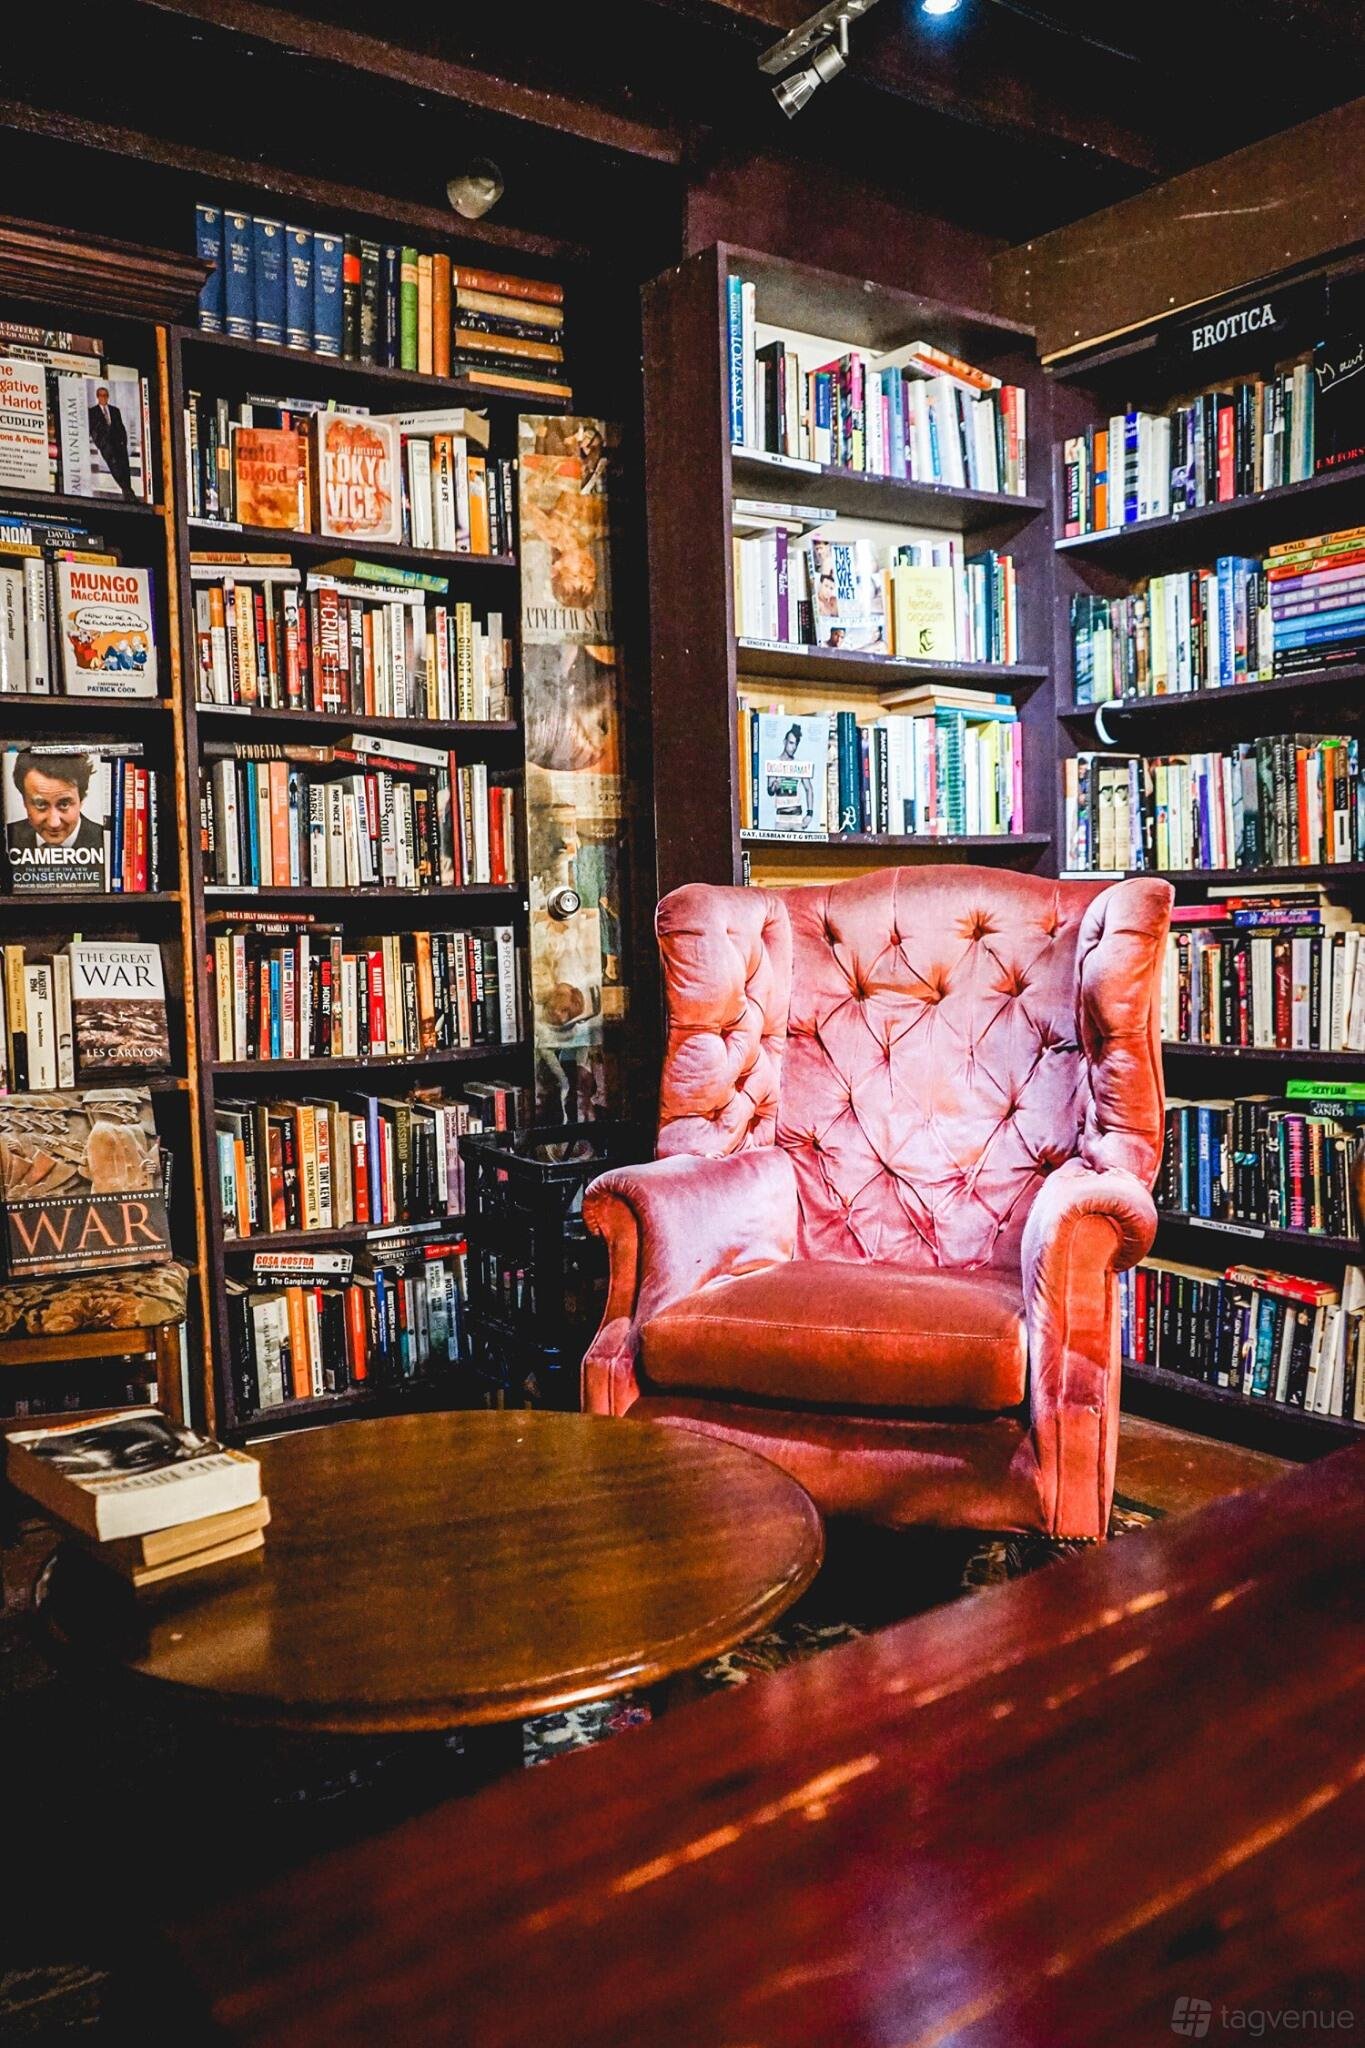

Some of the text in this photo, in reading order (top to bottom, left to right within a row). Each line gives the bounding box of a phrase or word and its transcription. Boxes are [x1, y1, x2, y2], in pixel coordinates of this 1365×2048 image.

[1191, 304, 1277, 352] EROTICA
[731, 336, 743, 373] LOVE
[0, 379, 38, 396] gative
[3, 395, 42, 411] Harlot
[0, 415, 44, 429] CUDLIPP
[68, 398, 79, 463] LYNEHAM
[23, 435, 45, 445] Power
[1337, 447, 1365, 463] FORS
[238, 462, 288, 483] blood
[324, 452, 391, 485] TOKYO
[328, 483, 375, 519] VICE
[0, 527, 32, 544] NOM
[45, 539, 78, 548] CROWE
[48, 530, 75, 540] DAVID
[834, 547, 850, 557] THE
[835, 562, 852, 573] DAY
[70, 572, 138, 593] MUNGO
[837, 574, 853, 587] WE
[838, 587, 855, 599] MET
[524, 607, 579, 630] WEEKLY
[321, 608, 338, 660] CRIME
[351, 610, 362, 648] DRIVE BY
[459, 637, 472, 712] GHOST PLANE
[87, 685, 116, 693] PATRICK
[235, 744, 282, 759] VENDETTA
[333, 790, 339, 802] MR
[384, 774, 393, 814] RESTLESS
[309, 788, 317, 821] MARKS
[381, 814, 389, 843] SOULS
[404, 812, 412, 848] CASEBOOK
[759, 832, 785, 840] LESBIAN
[9, 848, 104, 865] CAMERON
[13, 872, 100, 882] CONSERVATIVE
[256, 924, 290, 932] SPY HANDLER
[78, 953, 152, 964] THE GREAT
[284, 951, 293, 970] CRIME
[474, 939, 482, 972] BEYOND
[37, 970, 47, 1000] AUGUST
[80, 965, 155, 987] WAR
[503, 946, 513, 1020] SPECIAL BRANCH
[321, 962, 330, 1015] BLOOD MONEY
[86, 1048, 163, 1058] LES CARLYON
[1312, 1086, 1346, 1095] SEXY LIAR
[1313, 1108, 1344, 1116] SANDS
[303, 1109, 314, 1153] ADENAUER
[318, 1121, 327, 1146] CRUNCH
[397, 1111, 407, 1159] CROSSROAD
[1290, 1149, 1302, 1177] MILLER
[319, 1166, 329, 1184] TONY
[28, 1198, 83, 1208] DEFINITIVE
[86, 1195, 118, 1203] VISUAL
[122, 1192, 161, 1200] HISTORY
[320, 1187, 330, 1208] KEVIN
[1291, 1196, 1304, 1226] PLEXUS
[8, 1202, 165, 1254] WAR
[256, 1256, 314, 1266] COSA NOSTRA
[377, 1251, 405, 1261] THIRTEEN
[284, 1277, 314, 1287] Gangland
[316, 1278, 330, 1286] War
[1230, 1272, 1256, 1287] KINK
[445, 1278, 453, 1301] HOTEL
